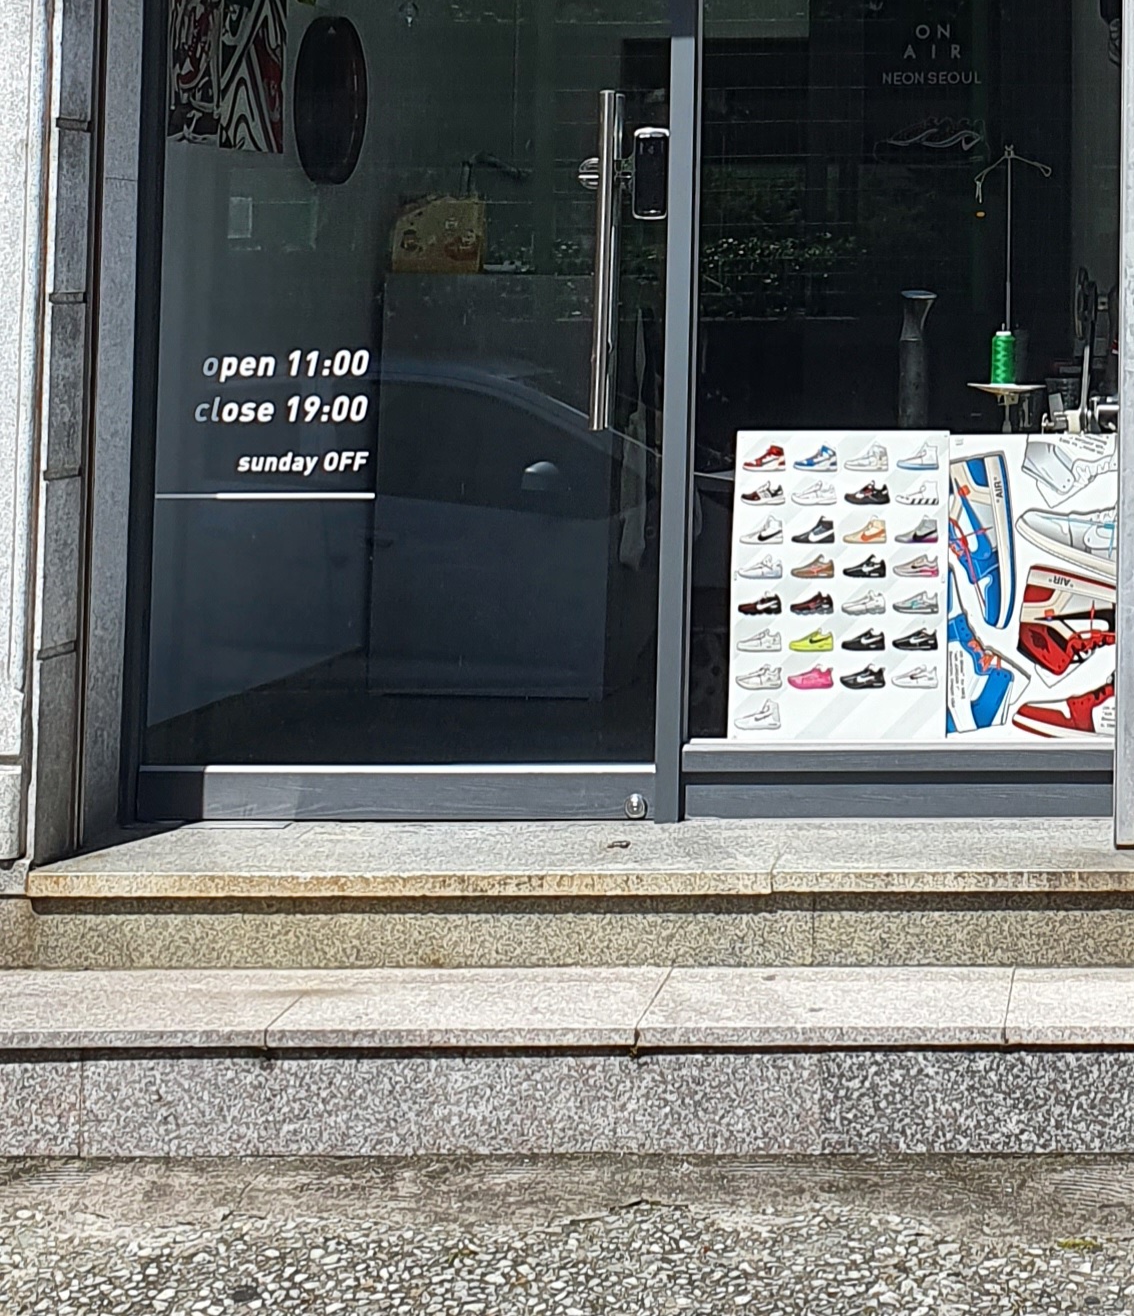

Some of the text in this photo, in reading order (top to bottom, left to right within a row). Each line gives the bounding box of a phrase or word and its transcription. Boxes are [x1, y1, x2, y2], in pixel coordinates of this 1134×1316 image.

[915, 24, 951, 40] ON
[903, 44, 962, 60] AIR
[882, 71, 982, 85] NEON SEOUL
[202, 349, 370, 383] open 11:00
[194, 394, 369, 423] close 19:00
[236, 451, 369, 476] sunday OFF
